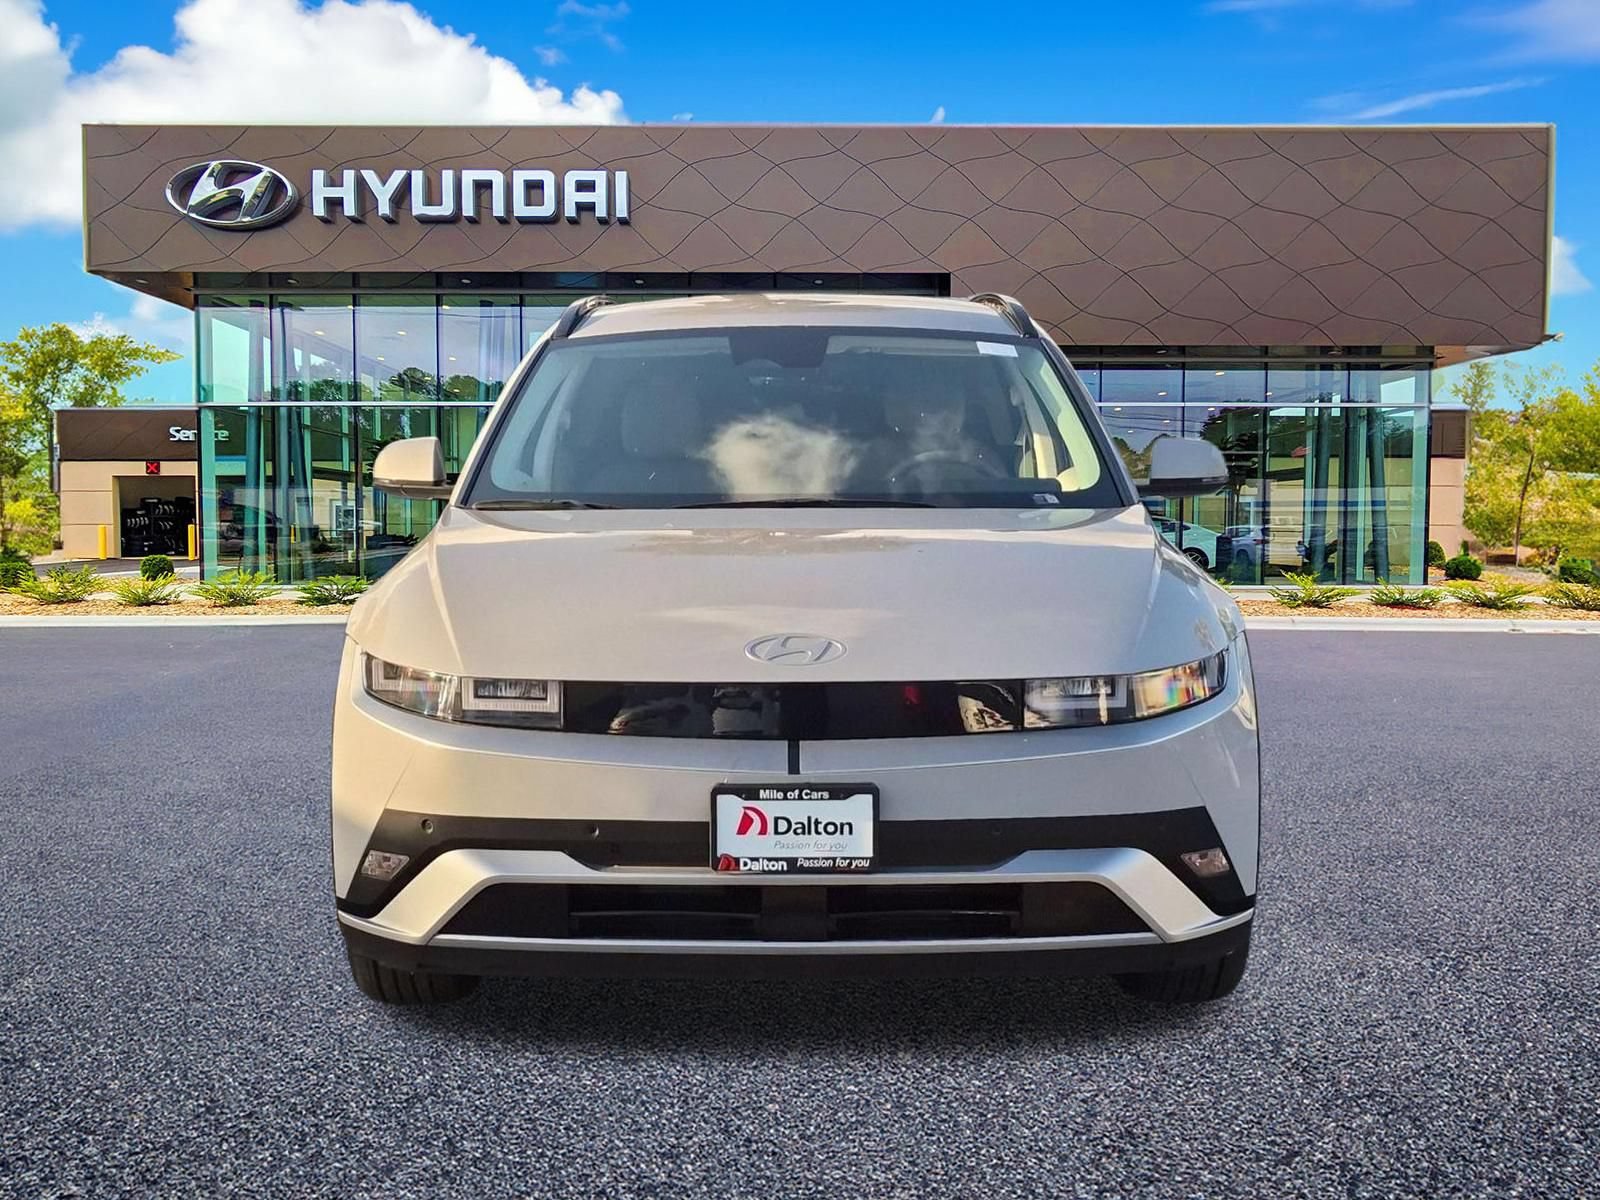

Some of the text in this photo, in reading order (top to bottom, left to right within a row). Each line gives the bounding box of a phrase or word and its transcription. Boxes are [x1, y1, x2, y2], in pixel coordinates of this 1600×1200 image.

[311, 169, 630, 223] HYUNDAI
[169, 427, 230, 441] Serce
[759, 789, 830, 800] Mile of Cars
[773, 816, 853, 836] Dalton
[774, 840, 848, 851] Passion for you
[740, 858, 787, 871] Dalton
[797, 858, 870, 869] Passion for you
